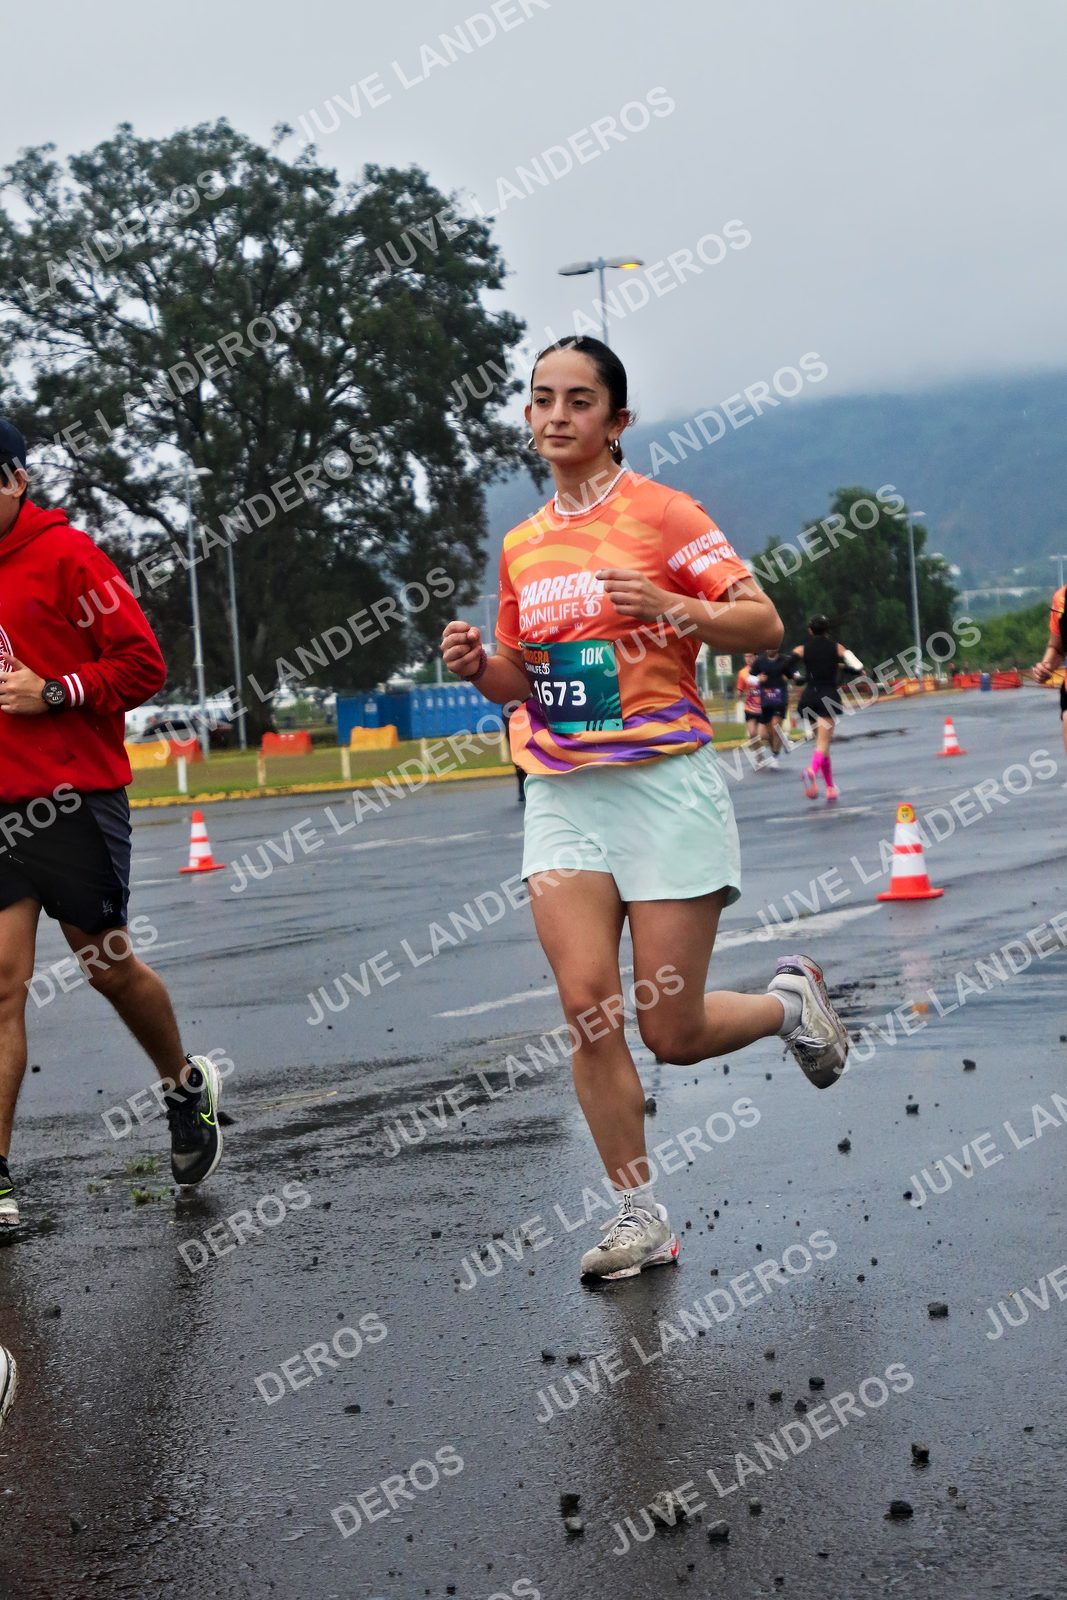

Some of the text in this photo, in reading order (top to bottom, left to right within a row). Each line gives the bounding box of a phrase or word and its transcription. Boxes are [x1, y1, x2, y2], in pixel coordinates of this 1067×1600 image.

[520, 570, 605, 611] CARRERA
[580, 646, 604, 666] 10K
[533, 680, 587, 707] 1673
